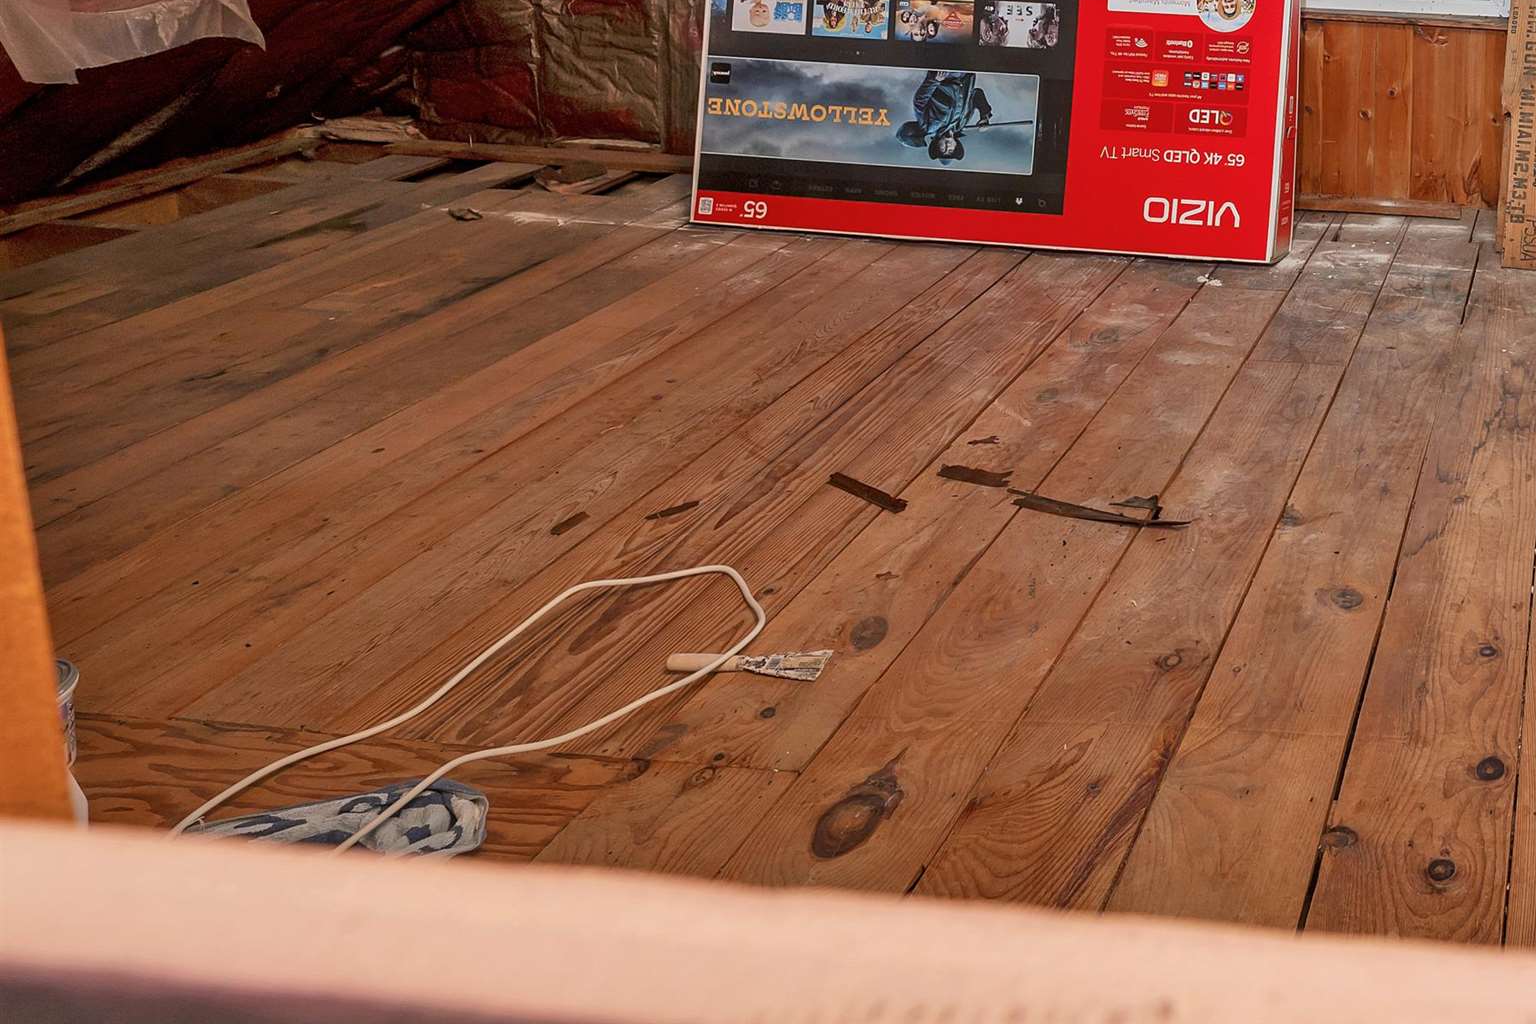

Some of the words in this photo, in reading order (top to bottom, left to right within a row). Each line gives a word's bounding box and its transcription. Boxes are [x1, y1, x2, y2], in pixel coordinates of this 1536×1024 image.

[1006, 5, 1034, 17] SEE
[707, 97, 891, 126] YELLOWSTONE
[1188, 108, 1233, 126] QLED
[1099, 145, 1119, 160] TV
[1121, 146, 1162, 162] Smart
[1163, 148, 1201, 165] QLED
[1202, 151, 1223, 166] 4K
[1142, 196, 1241, 228] VIZIO
